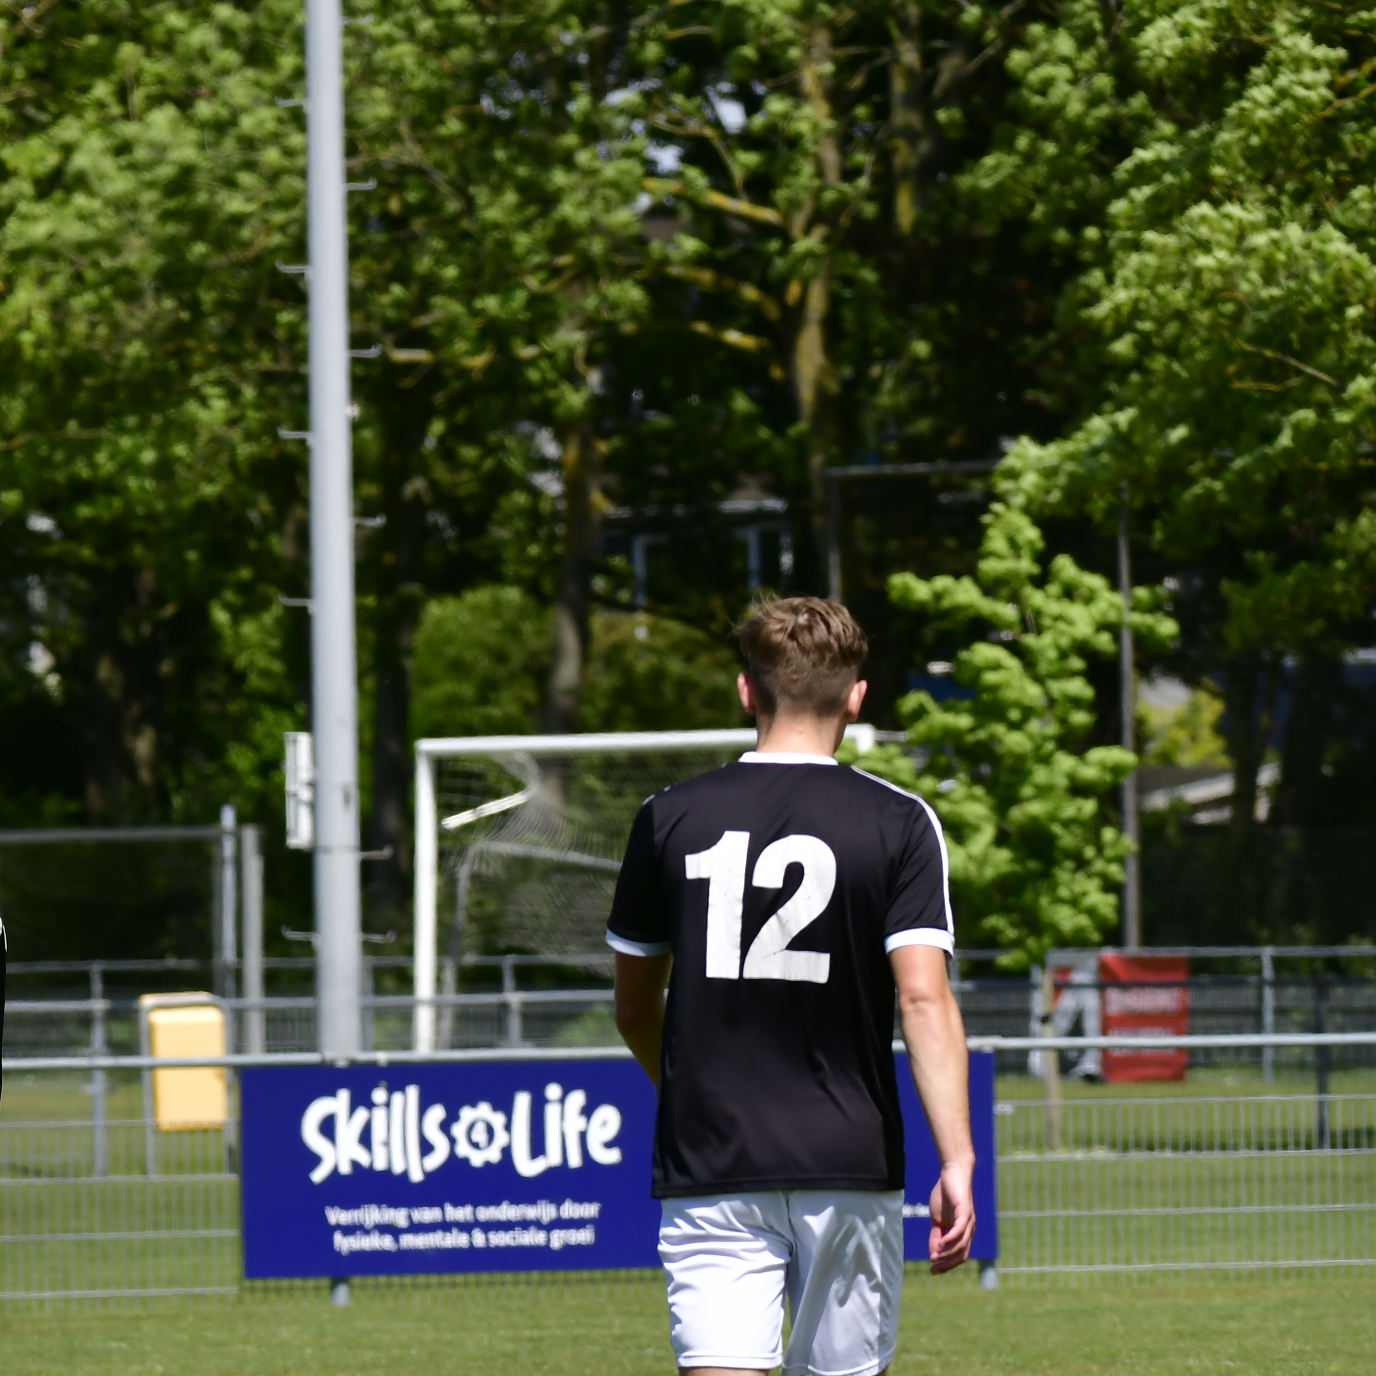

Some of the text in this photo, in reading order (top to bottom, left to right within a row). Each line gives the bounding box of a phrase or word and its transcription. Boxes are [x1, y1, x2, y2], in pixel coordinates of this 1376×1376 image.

[685, 830, 837, 983] 12
[301, 1083, 450, 1184] Skills
[511, 1082, 622, 1177] Life
[325, 1198, 601, 1229] Verrijking van het onderwijs door
[399, 1227, 470, 1250] mentale
[471, 1227, 487, 1248] &
[487, 1225, 548, 1247] sociale
[549, 1223, 596, 1250] groei
